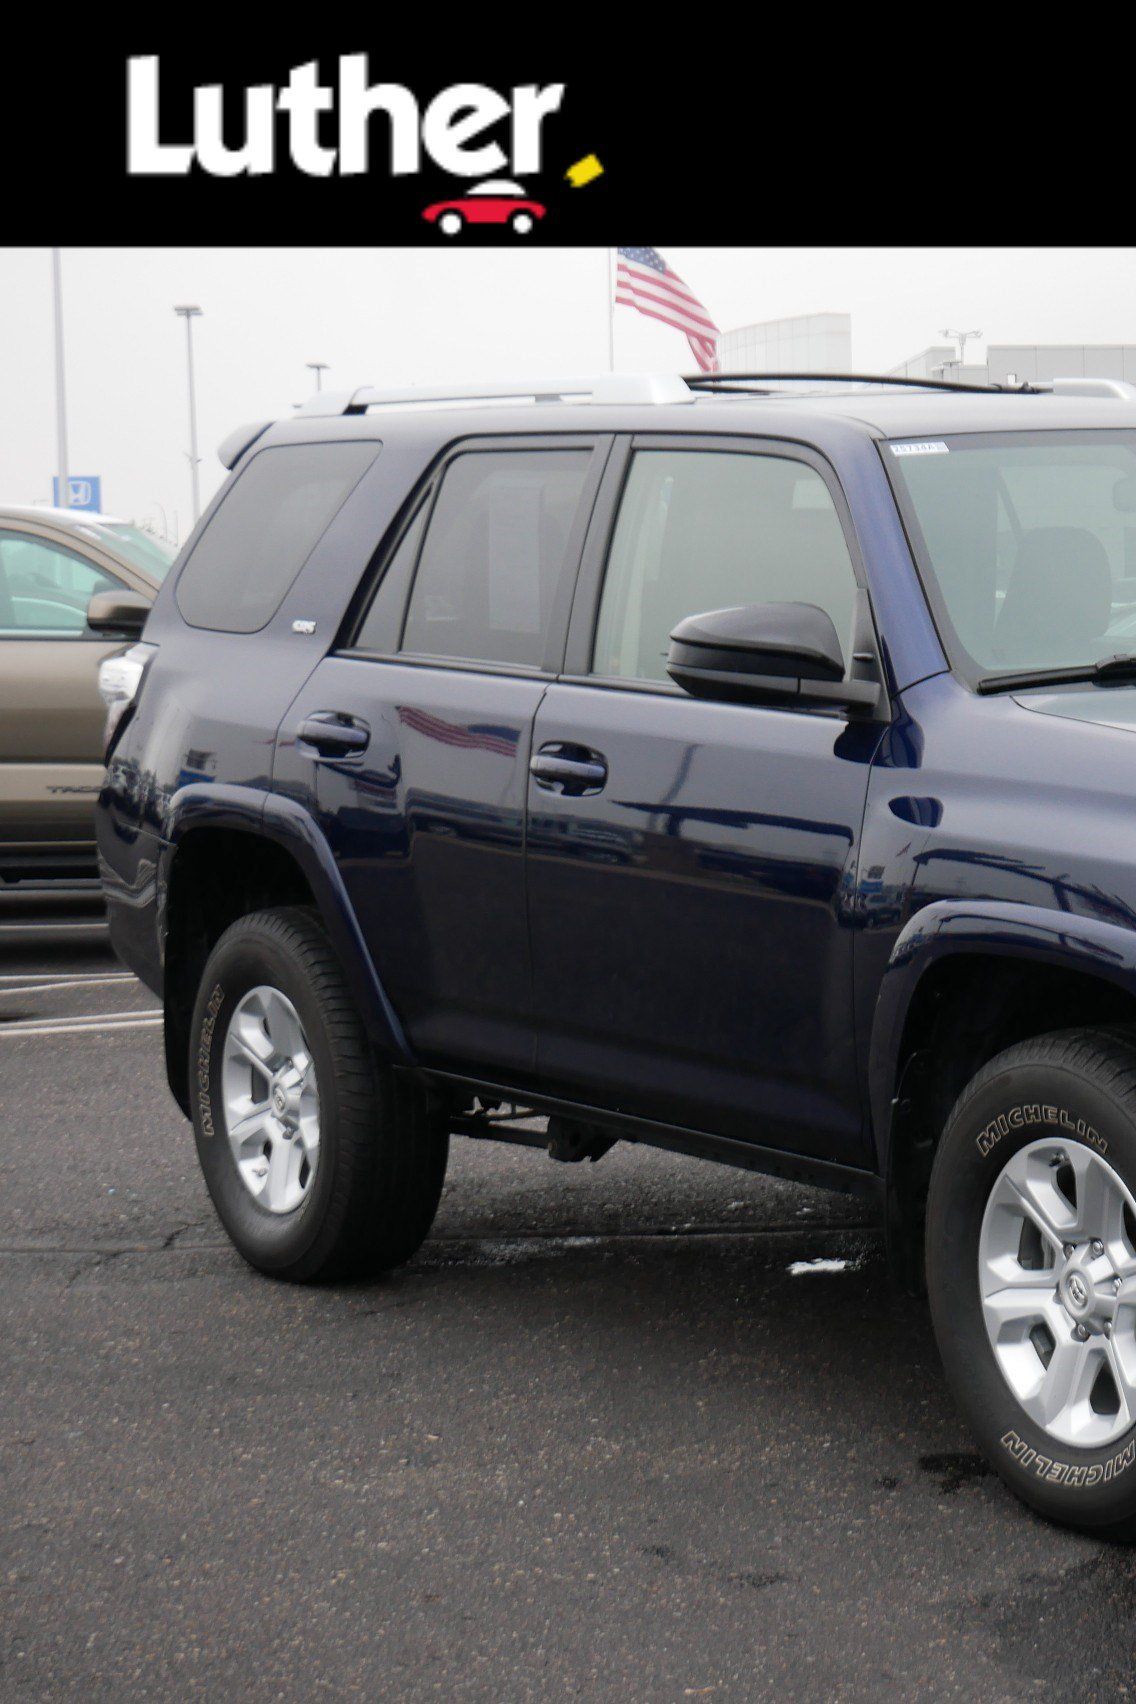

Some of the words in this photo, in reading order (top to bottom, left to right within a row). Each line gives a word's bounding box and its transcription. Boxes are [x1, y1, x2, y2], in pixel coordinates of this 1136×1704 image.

[199, 983, 226, 1137] MICHELIN
[976, 1104, 1109, 1158] MICHELIN
[1000, 1430, 1136, 1487] MICHELIN
